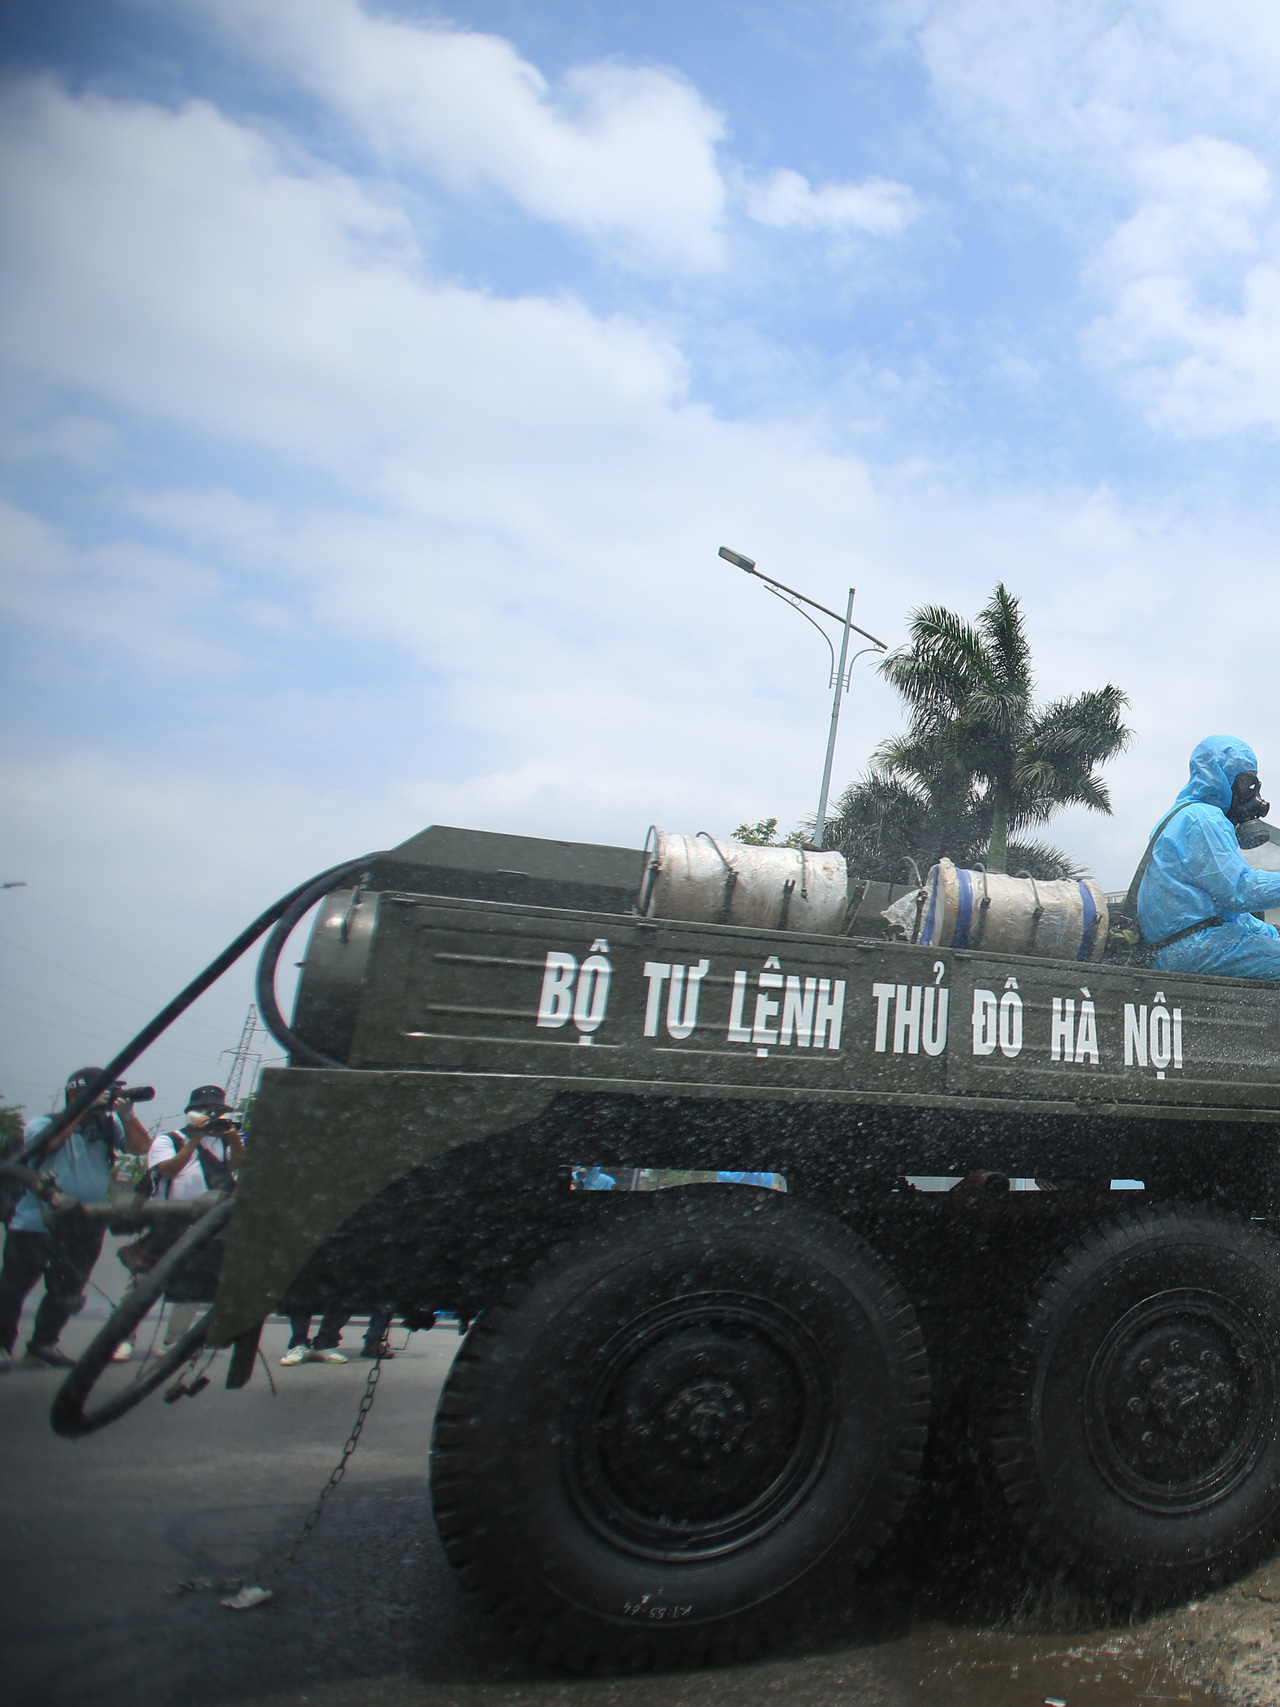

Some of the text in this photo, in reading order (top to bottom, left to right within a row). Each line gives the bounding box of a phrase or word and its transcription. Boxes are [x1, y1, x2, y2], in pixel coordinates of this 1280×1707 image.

[536, 938, 1183, 1080] BỘ TƯ LỆNH THỦ ĐÔ HÀ NỘI
